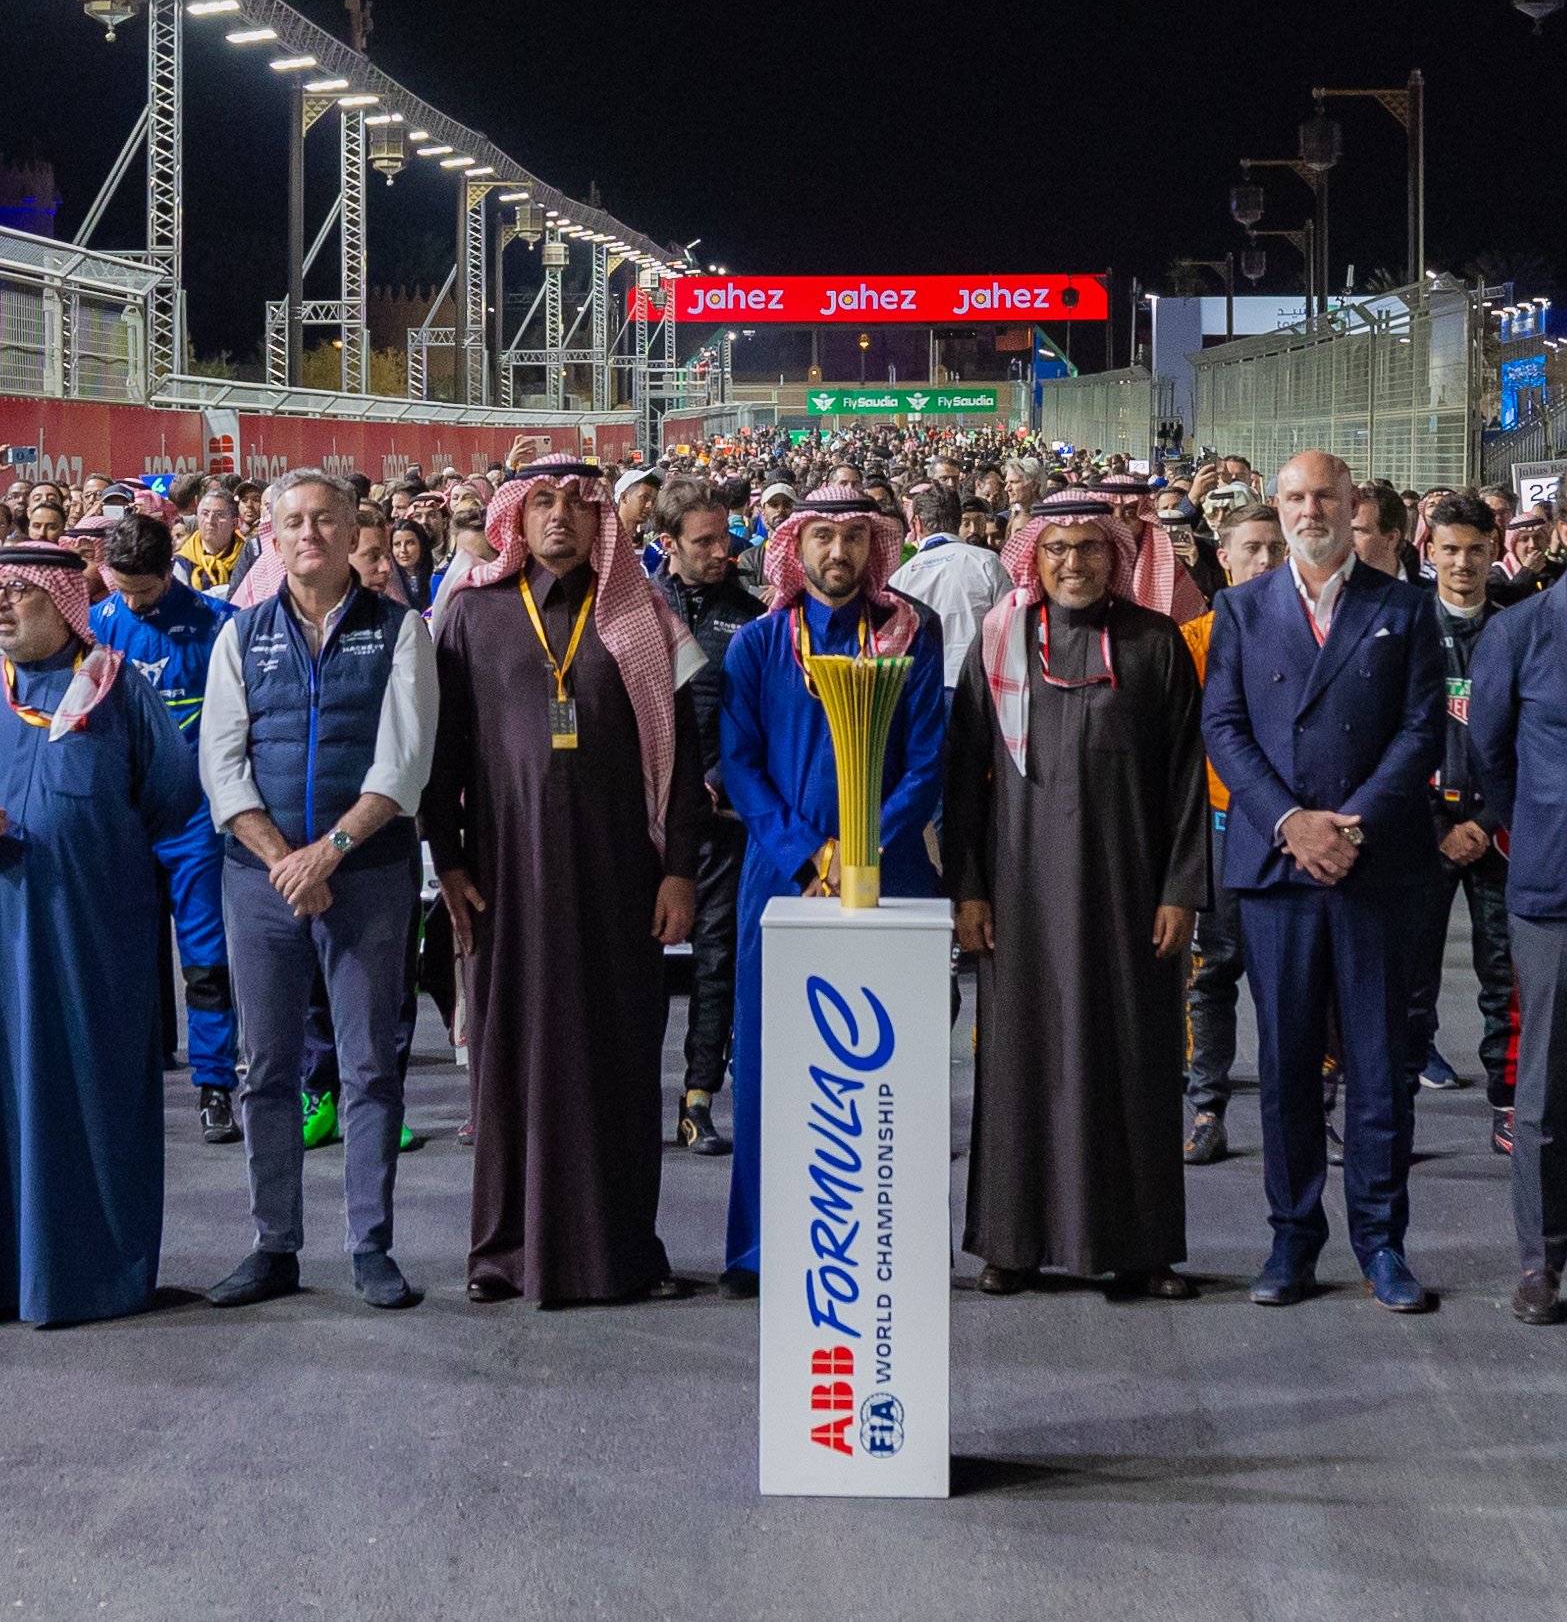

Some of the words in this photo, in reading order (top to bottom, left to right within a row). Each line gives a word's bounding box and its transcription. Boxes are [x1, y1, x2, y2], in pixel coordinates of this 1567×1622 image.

[687, 282, 784, 315] jahez
[820, 283, 917, 315] jahez
[953, 282, 1049, 315] jahez
[151, 477, 167, 492] 4
[1519, 466, 1548, 477] Julius
[1529, 484, 1559, 502] 22
[807, 1064, 865, 1339] FORMULA
[876, 1082, 894, 1282] CHAMPIONSHIP
[876, 1294, 893, 1384] WORLD
[810, 1344, 855, 1458] ABB
